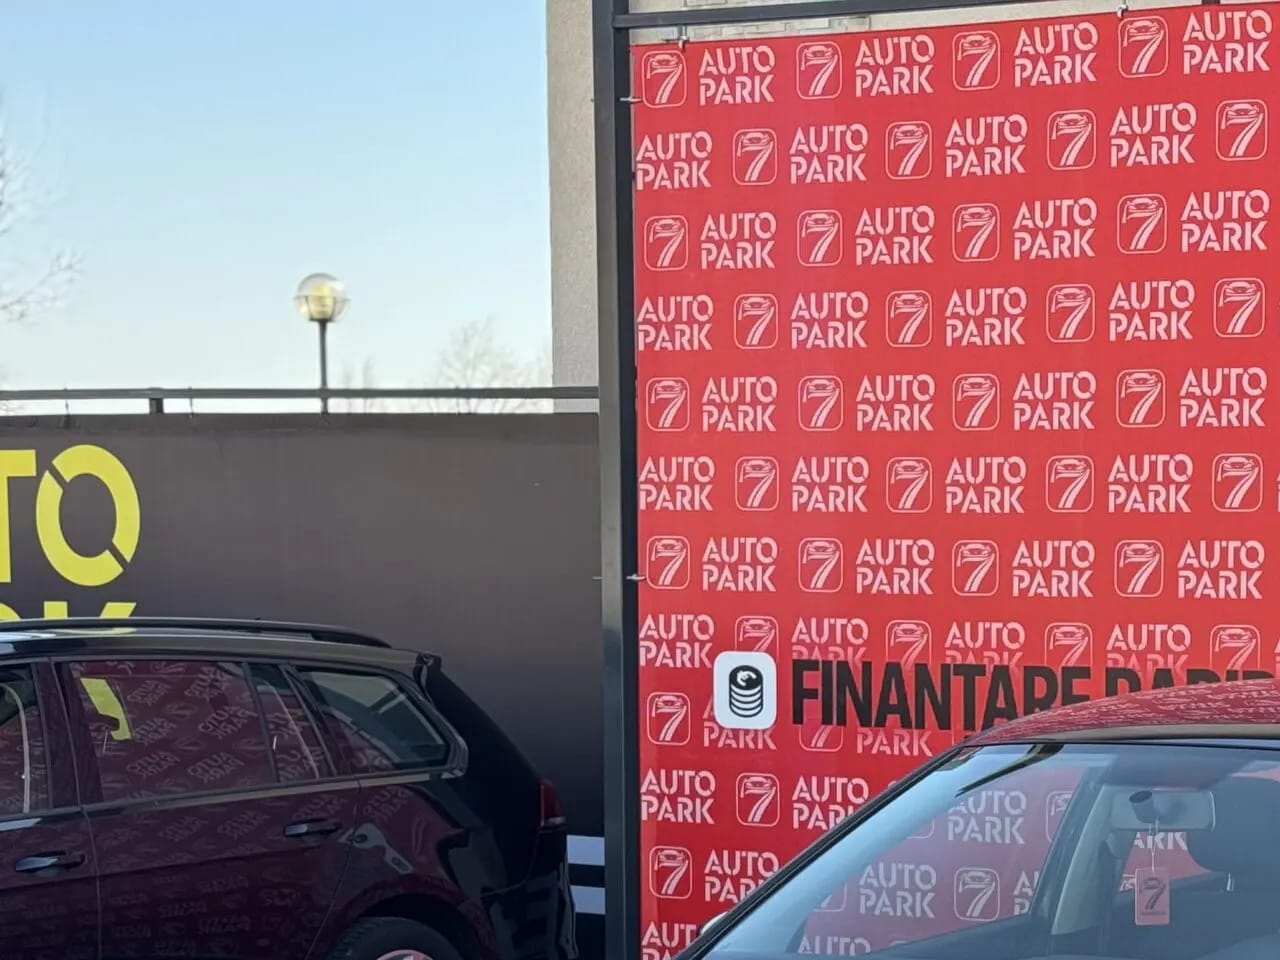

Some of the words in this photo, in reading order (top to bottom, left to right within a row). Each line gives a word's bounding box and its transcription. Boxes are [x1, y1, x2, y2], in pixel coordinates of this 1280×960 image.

[1014, 22, 1097, 56] AUTO
[1183, 10, 1272, 42] AUTO
[699, 45, 774, 75] AUTO
[855, 35, 934, 66] AUTO
[1184, 41, 1269, 74] PARK
[856, 65, 933, 97] PARK
[1015, 53, 1096, 87] PARK
[700, 75, 774, 105] PARK
[945, 114, 1027, 147] AUTO
[1110, 103, 1196, 136] AUTO
[636, 131, 712, 161] AUTO
[790, 124, 868, 154] AUTO
[1111, 134, 1194, 167] PARK
[637, 160, 711, 190] PARK
[791, 153, 866, 184] PARK
[946, 145, 1025, 177] PARK
[1013, 198, 1097, 229] AUTO
[1181, 190, 1269, 221] AUTO
[701, 212, 776, 240] AUTO
[855, 205, 934, 235] AUTO
[856, 235, 933, 265] PARK
[1014, 228, 1095, 260] PARK
[1182, 221, 1267, 252] PARK
[701, 241, 774, 269] PARK
[637, 295, 713, 322] AUTO
[791, 291, 868, 319] AUTO
[945, 287, 1026, 316] AUTO
[1109, 280, 1194, 310] AUTO
[638, 324, 712, 350] PARK
[792, 320, 866, 349] PARK
[946, 317, 1025, 346] PARK
[1110, 311, 1192, 341] PARK
[702, 376, 777, 403] AUTO
[856, 374, 935, 401] AUTO
[1013, 371, 1096, 400] AUTO
[1180, 367, 1267, 396] AUTO
[703, 405, 776, 432] PARK
[857, 403, 933, 431] PARK
[1014, 401, 1094, 430] PARK
[1180, 398, 1265, 427] PARK
[639, 456, 714, 482] AUTO
[792, 457, 869, 483] AUTO
[945, 456, 1026, 484] AUTO
[1108, 454, 1193, 482] AUTO
[640, 484, 712, 510] PARK
[793, 485, 867, 512] PARK
[946, 486, 1024, 513] PARK
[1109, 484, 1190, 512] PARK
[0, 444, 141, 586] TO
[703, 537, 777, 563] AUTO
[856, 539, 934, 566] AUTO
[1012, 540, 1094, 568] AUTO
[1178, 540, 1264, 569] AUTO
[703, 564, 776, 591] PARK
[857, 567, 933, 594] PARK
[1013, 570, 1093, 597] PARK
[1178, 570, 1262, 599] PARK
[639, 614, 714, 640] AUTO
[792, 618, 868, 644] AUTO
[945, 622, 1025, 649] AUTO
[1107, 624, 1190, 651] AUTO
[640, 641, 711, 669] PARK
[703, 721, 777, 749] PARK
[857, 728, 932, 756] PARK
[640, 768, 715, 796] AUTO
[792, 776, 868, 804] AUTO
[641, 794, 714, 824] PARK
[948, 816, 1025, 844] PARK
[704, 850, 778, 877] AUTO
[860, 863, 937, 888] AUTO
[860, 890, 935, 918] PARK
